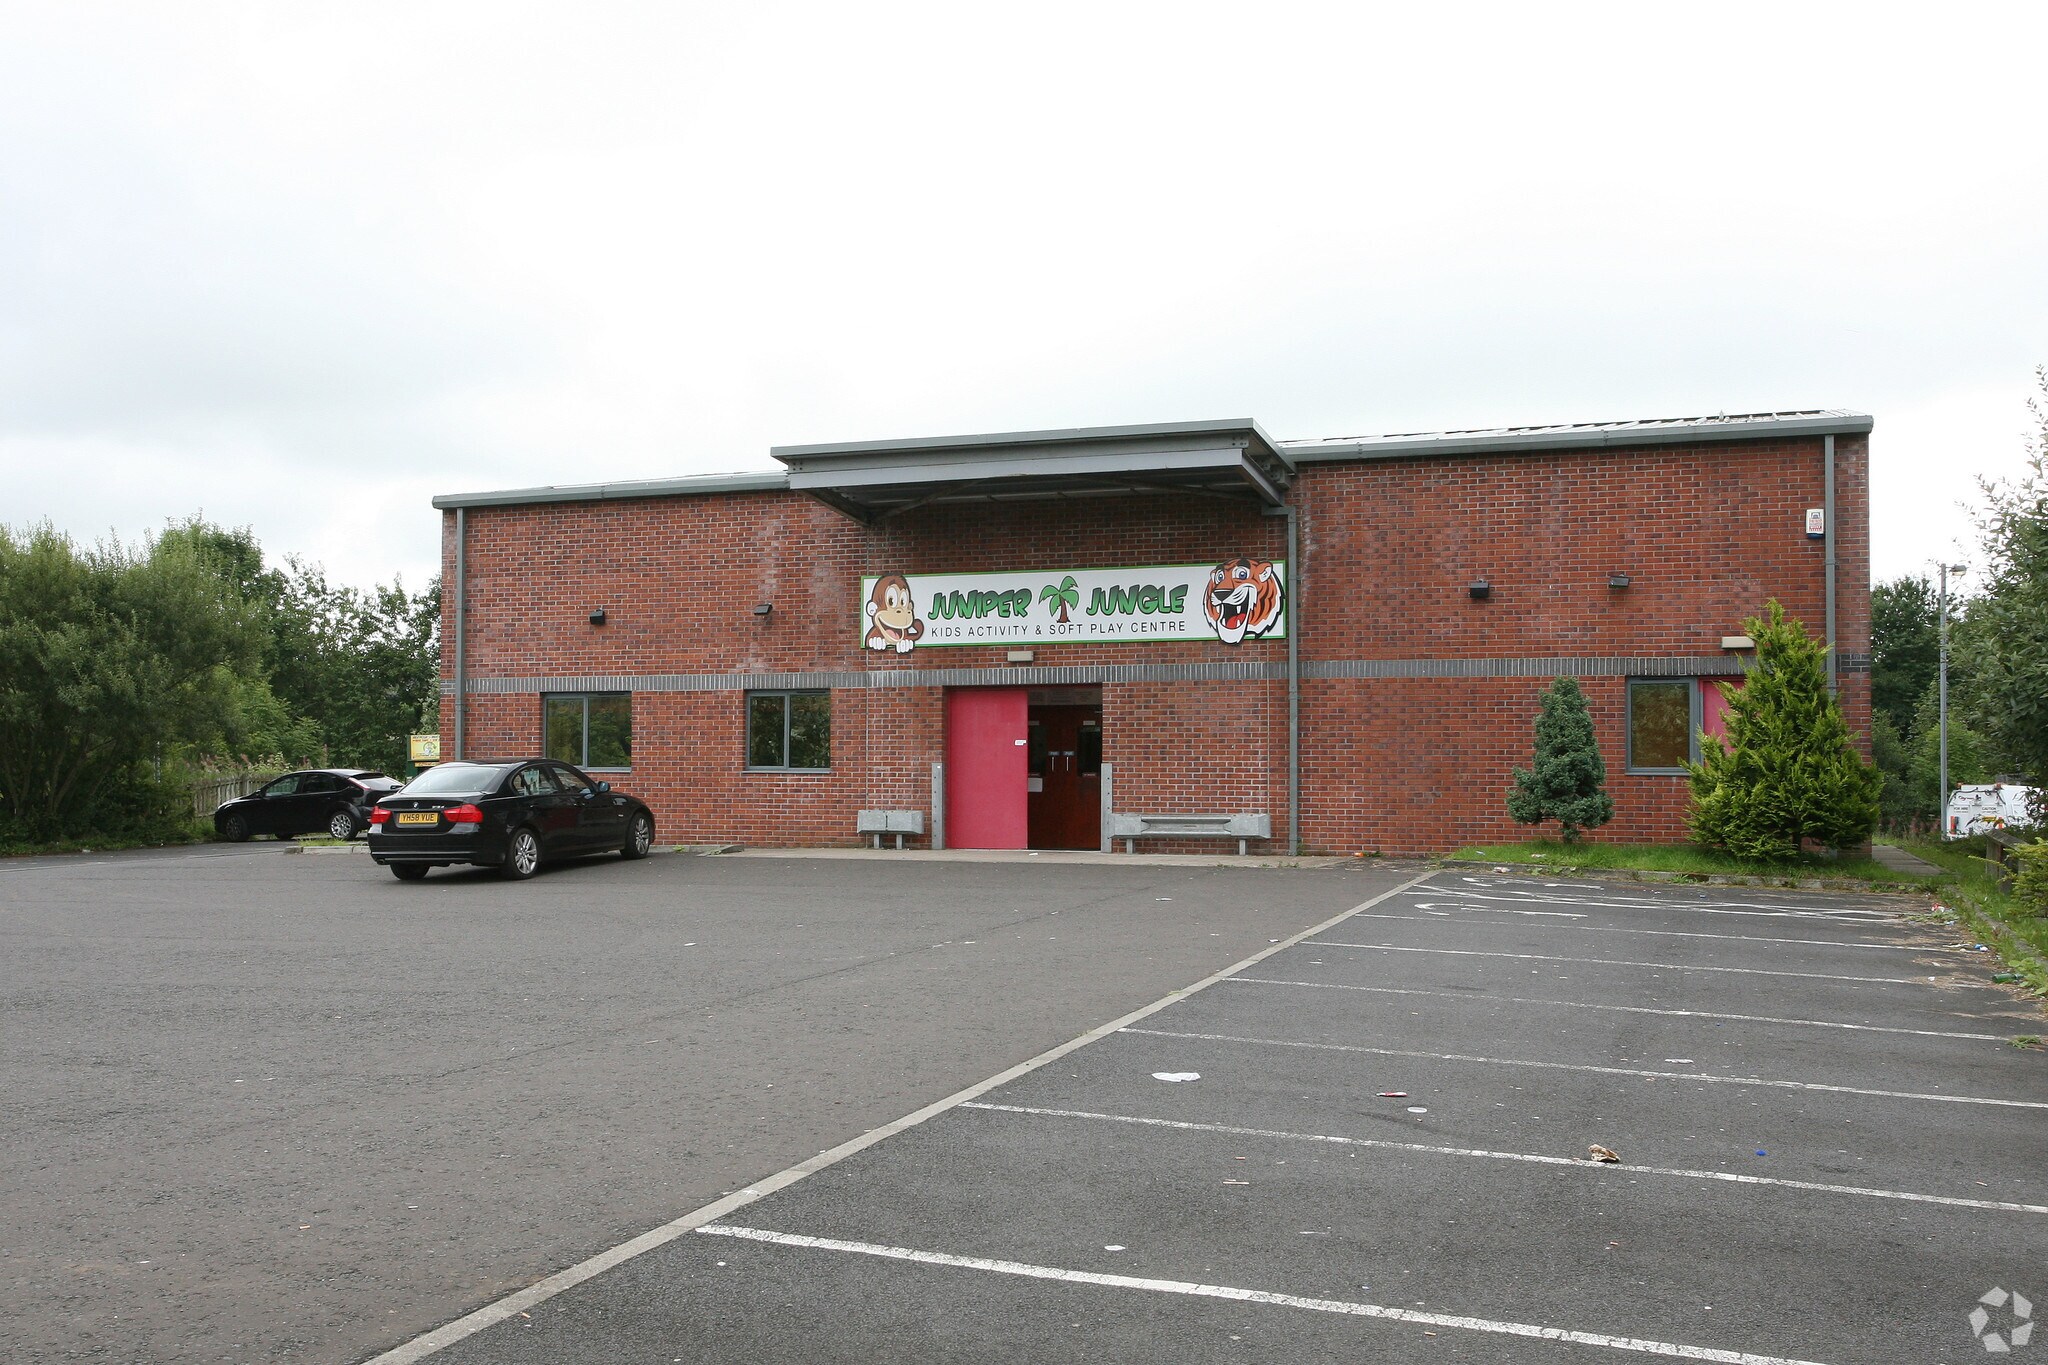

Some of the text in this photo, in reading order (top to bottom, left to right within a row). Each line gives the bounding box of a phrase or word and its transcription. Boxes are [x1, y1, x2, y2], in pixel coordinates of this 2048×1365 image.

[927, 584, 1189, 621] JUNIPER JUNGLE
[931, 621, 1186, 638] KIDS ACTIVITY & SOFT PLAY CENTRE
[402, 813, 420, 821] YH58
